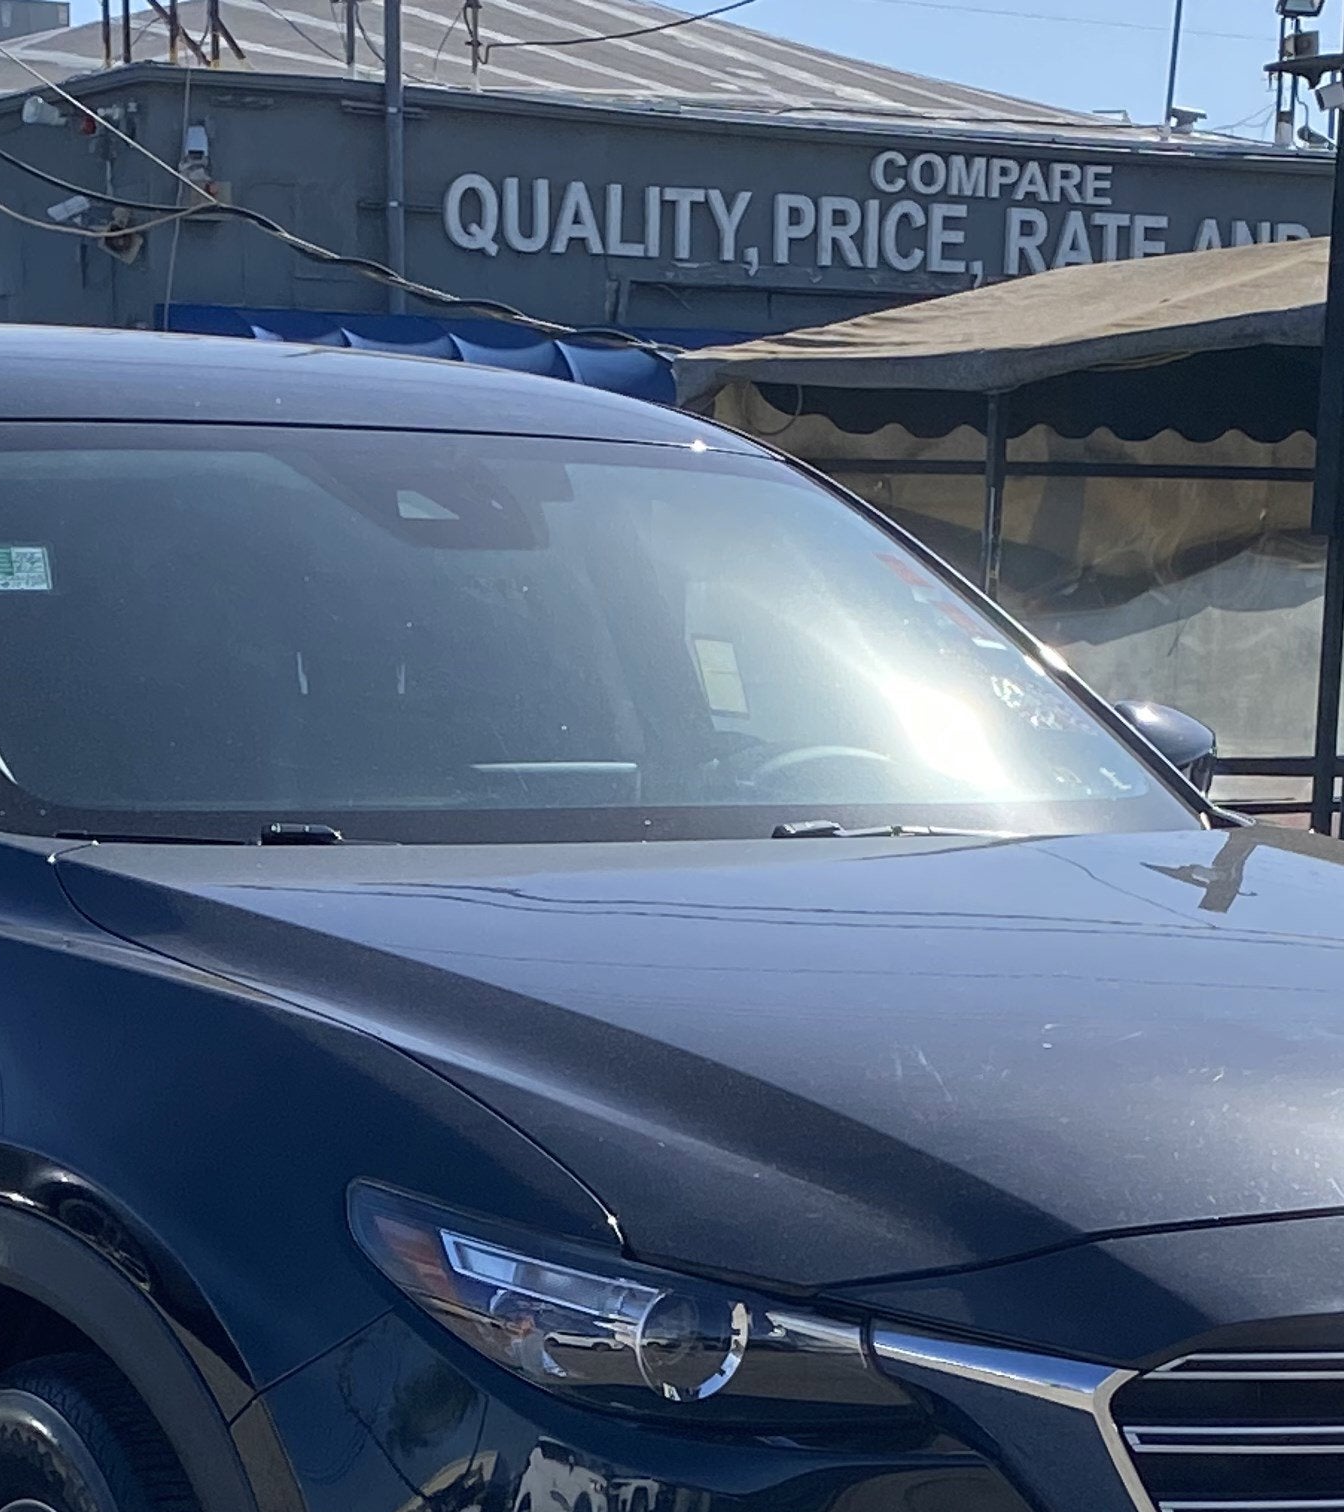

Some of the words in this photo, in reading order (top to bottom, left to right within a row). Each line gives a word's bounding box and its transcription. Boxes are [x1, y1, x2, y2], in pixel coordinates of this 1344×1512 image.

[871, 151, 1113, 206] COMPARE
[443, 173, 759, 276] QUALITY,
[773, 193, 984, 288] PRICE,
[1004, 207, 1169, 275] RATE
